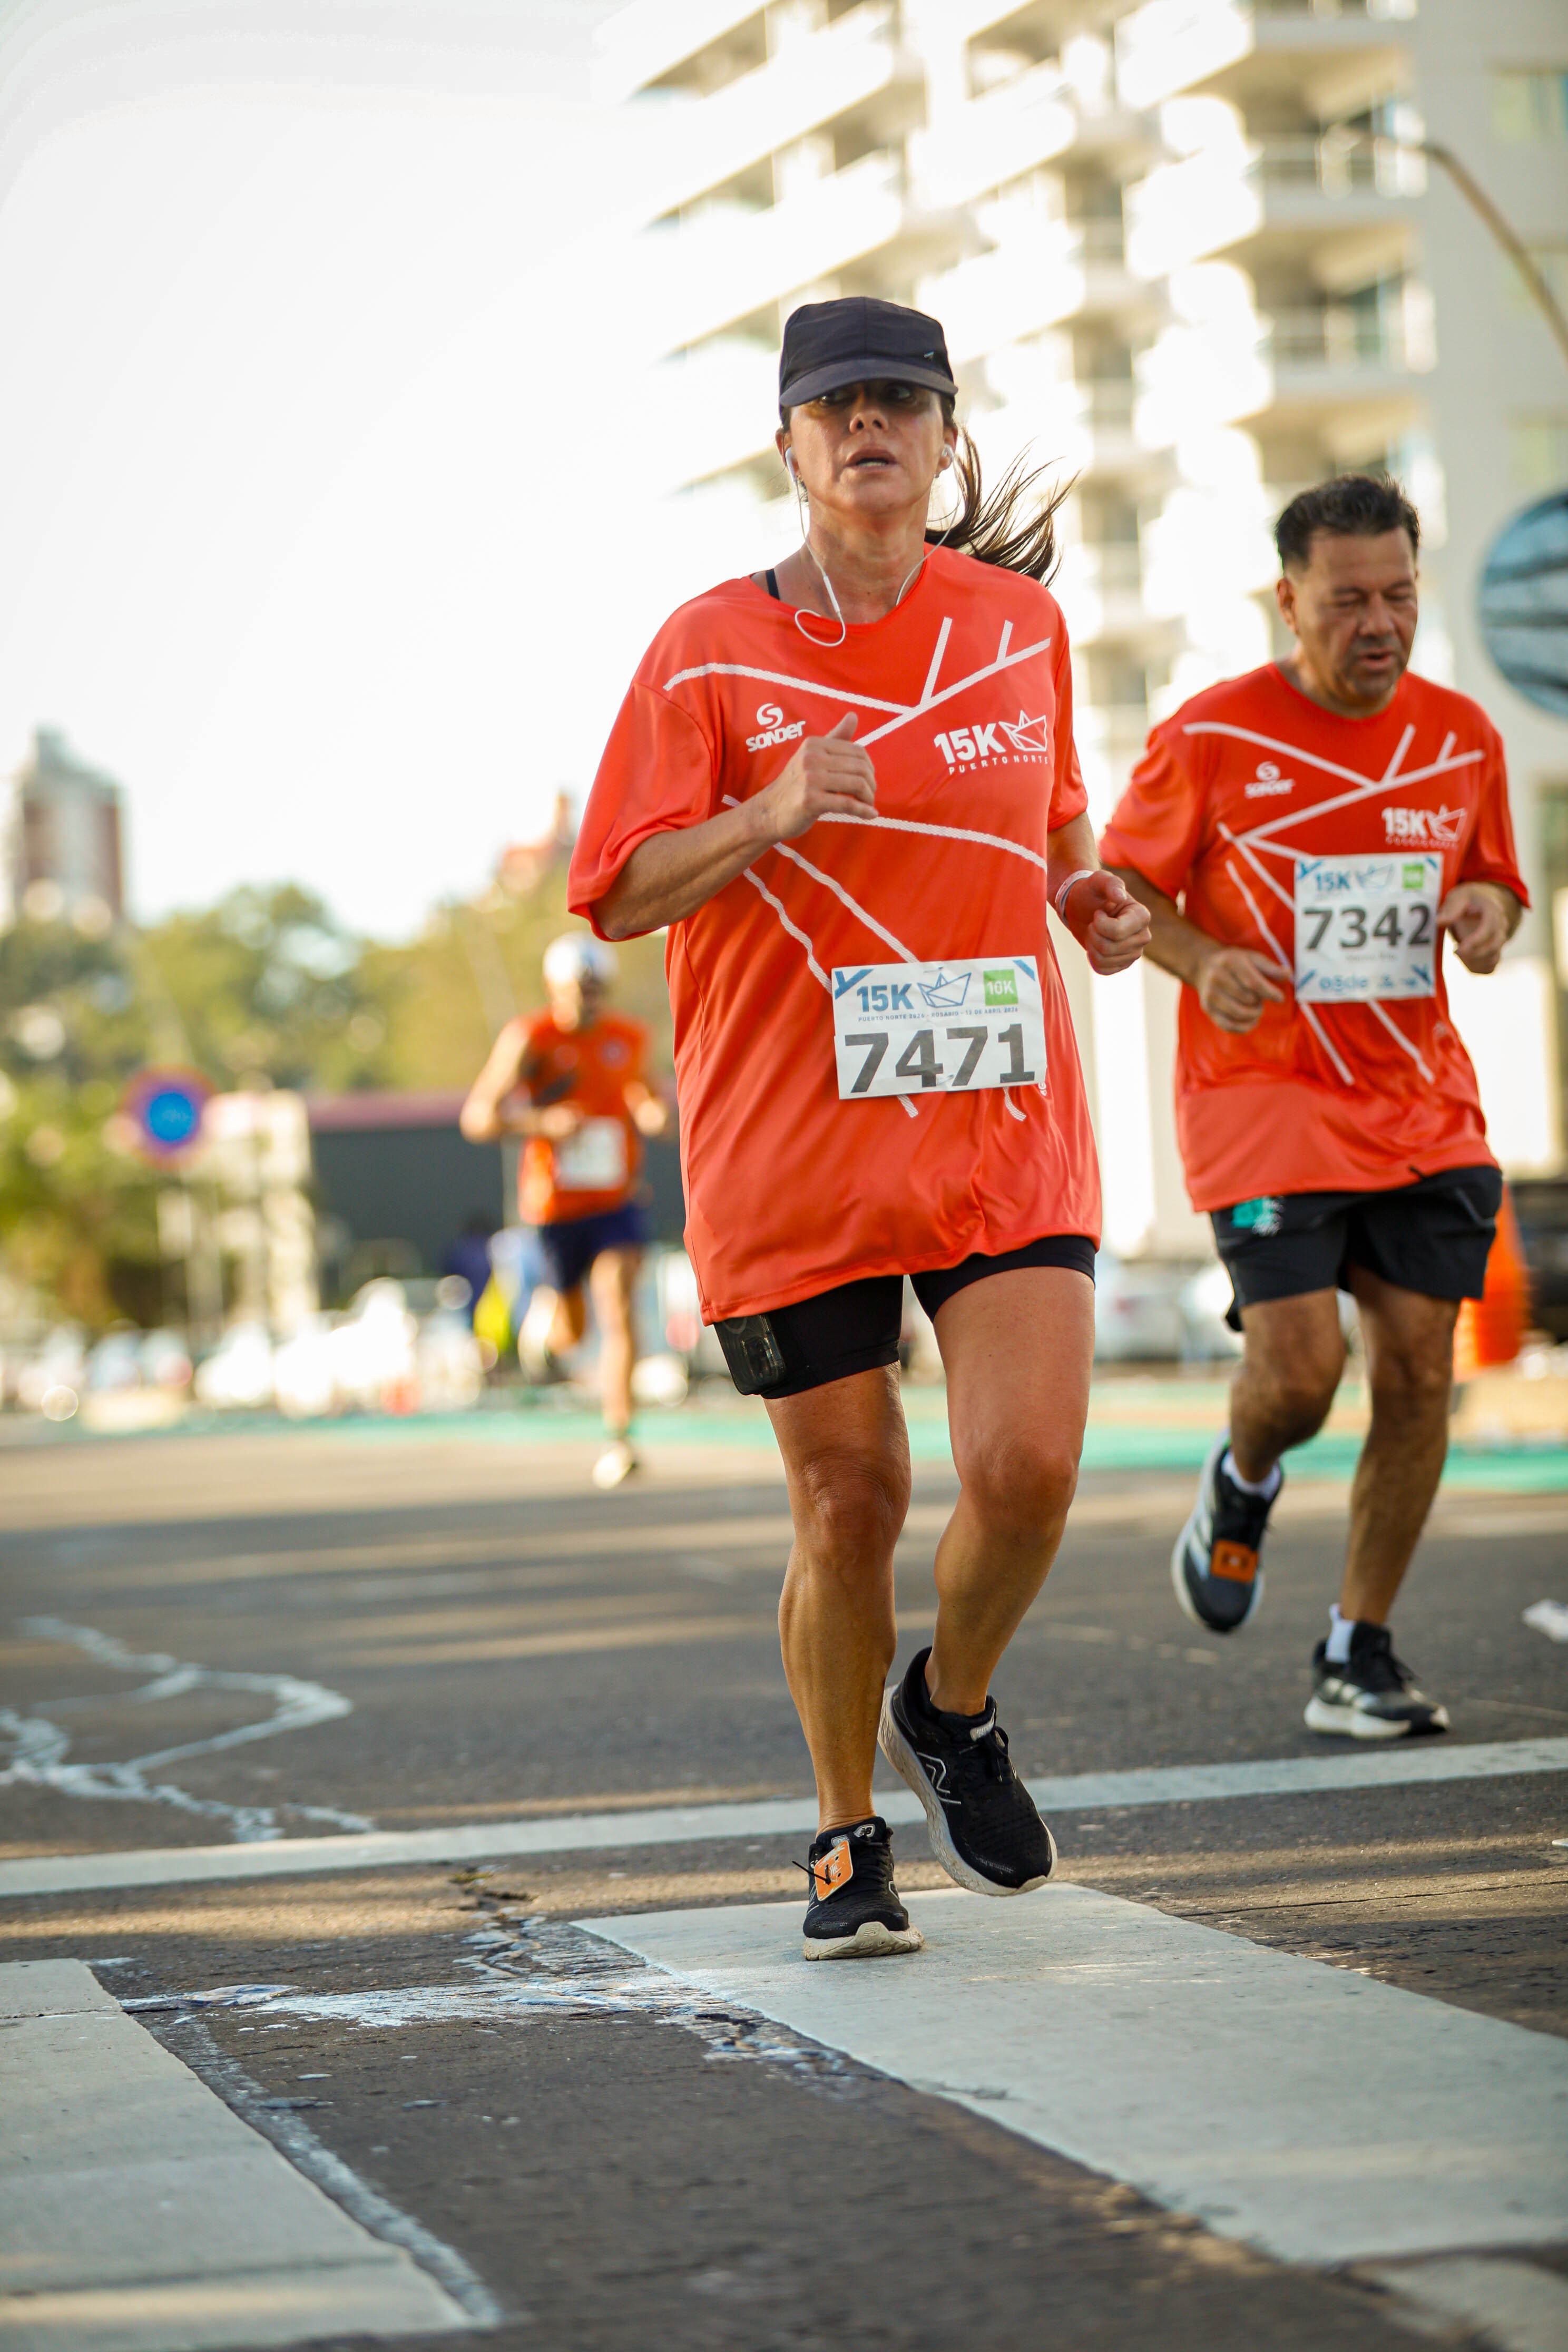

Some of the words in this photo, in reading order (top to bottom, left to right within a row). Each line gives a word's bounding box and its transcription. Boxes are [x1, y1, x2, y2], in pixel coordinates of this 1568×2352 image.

[934, 723, 1006, 764] 15K
[949, 757, 1008, 775] PUERTO
[1013, 754, 1048, 765] NORTE
[1381, 807, 1427, 838] 15K
[1315, 871, 1350, 891] 15K
[1303, 904, 1432, 950] 7342
[857, 983, 914, 1012] 15K
[986, 981, 1014, 995] 10K
[845, 1024, 1035, 1093] 7471
